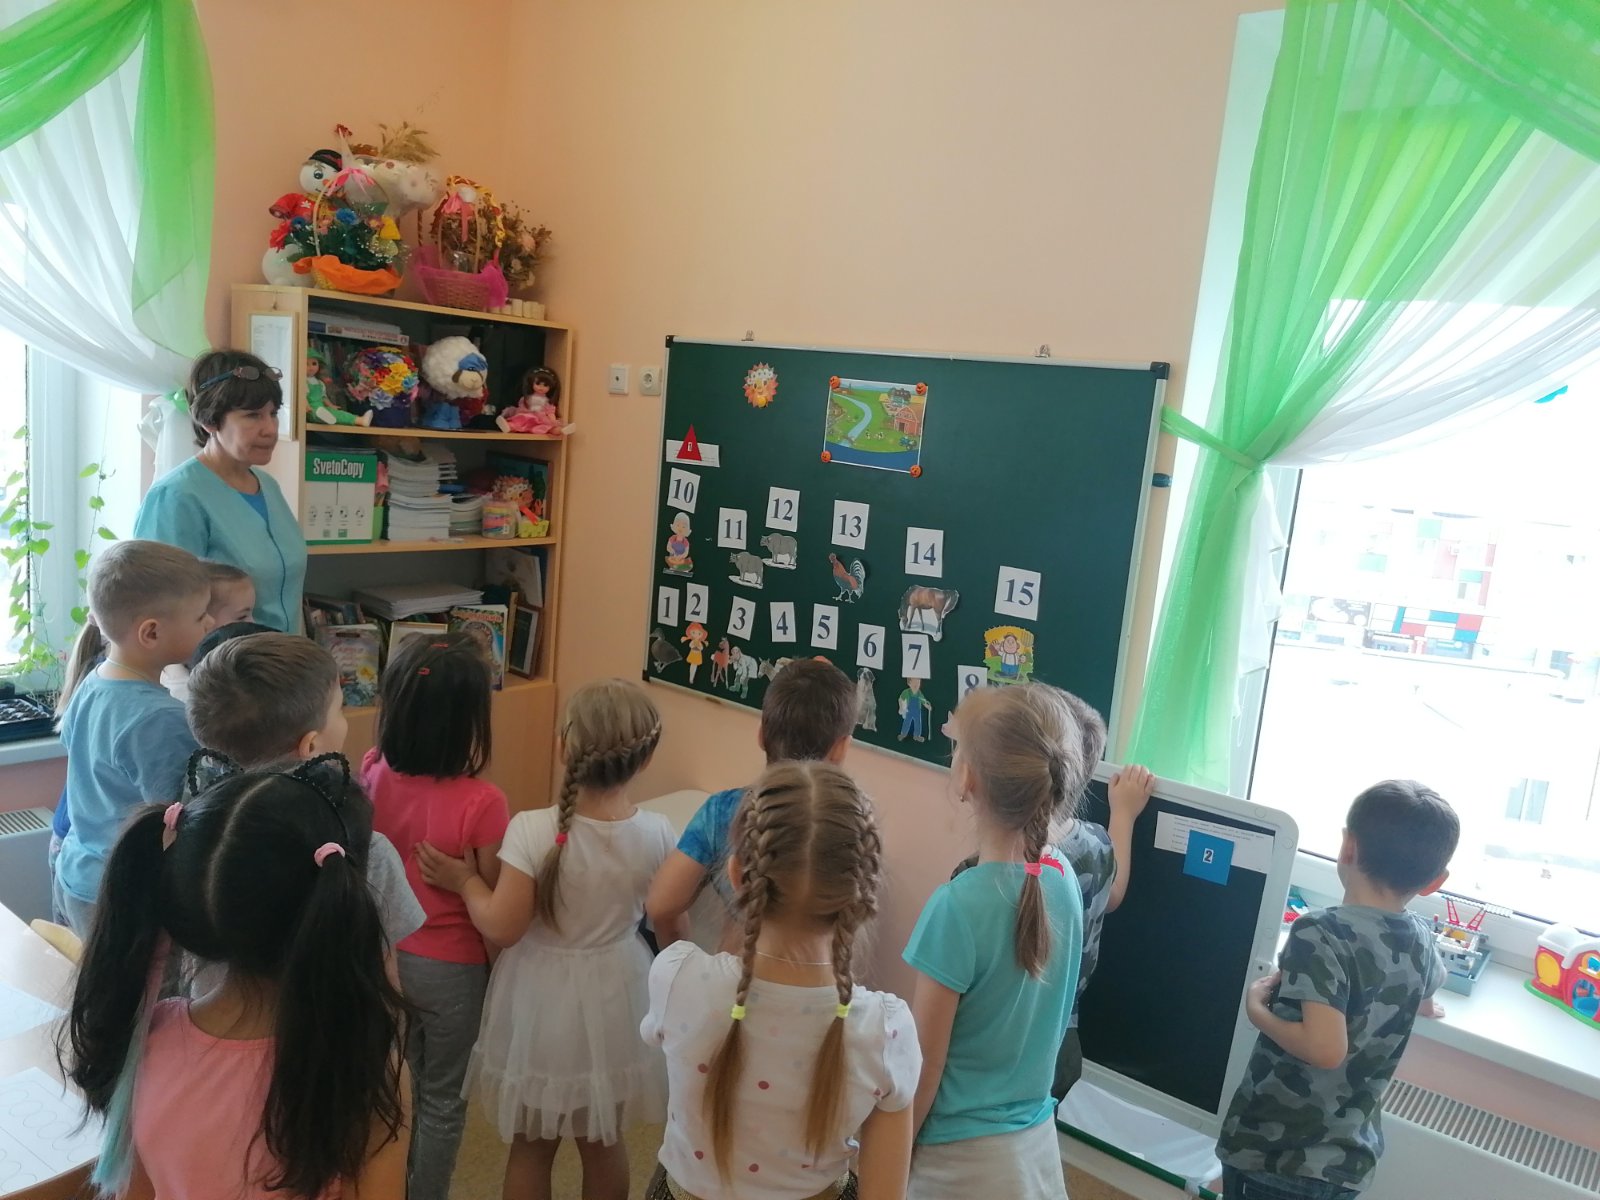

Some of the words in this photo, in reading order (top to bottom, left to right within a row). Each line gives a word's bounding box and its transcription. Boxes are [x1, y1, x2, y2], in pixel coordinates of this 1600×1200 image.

[313, 457, 364, 478] SvetoCopy
[673, 478, 695, 504] 10
[772, 497, 793, 522] 12
[724, 518, 743, 541] 11
[839, 513, 862, 538] 13
[911, 541, 937, 566] 14
[690, 592, 701, 617] 2
[1004, 578, 1035, 606] 15
[663, 596, 671, 619] 1
[733, 606, 747, 631] 3
[776, 610, 789, 636] 4
[817, 615, 831, 640] 5
[863, 632, 877, 658] 6
[908, 643, 922, 670] 7
[965, 673, 980, 697] 8
[1203, 849, 1213, 863] 2
